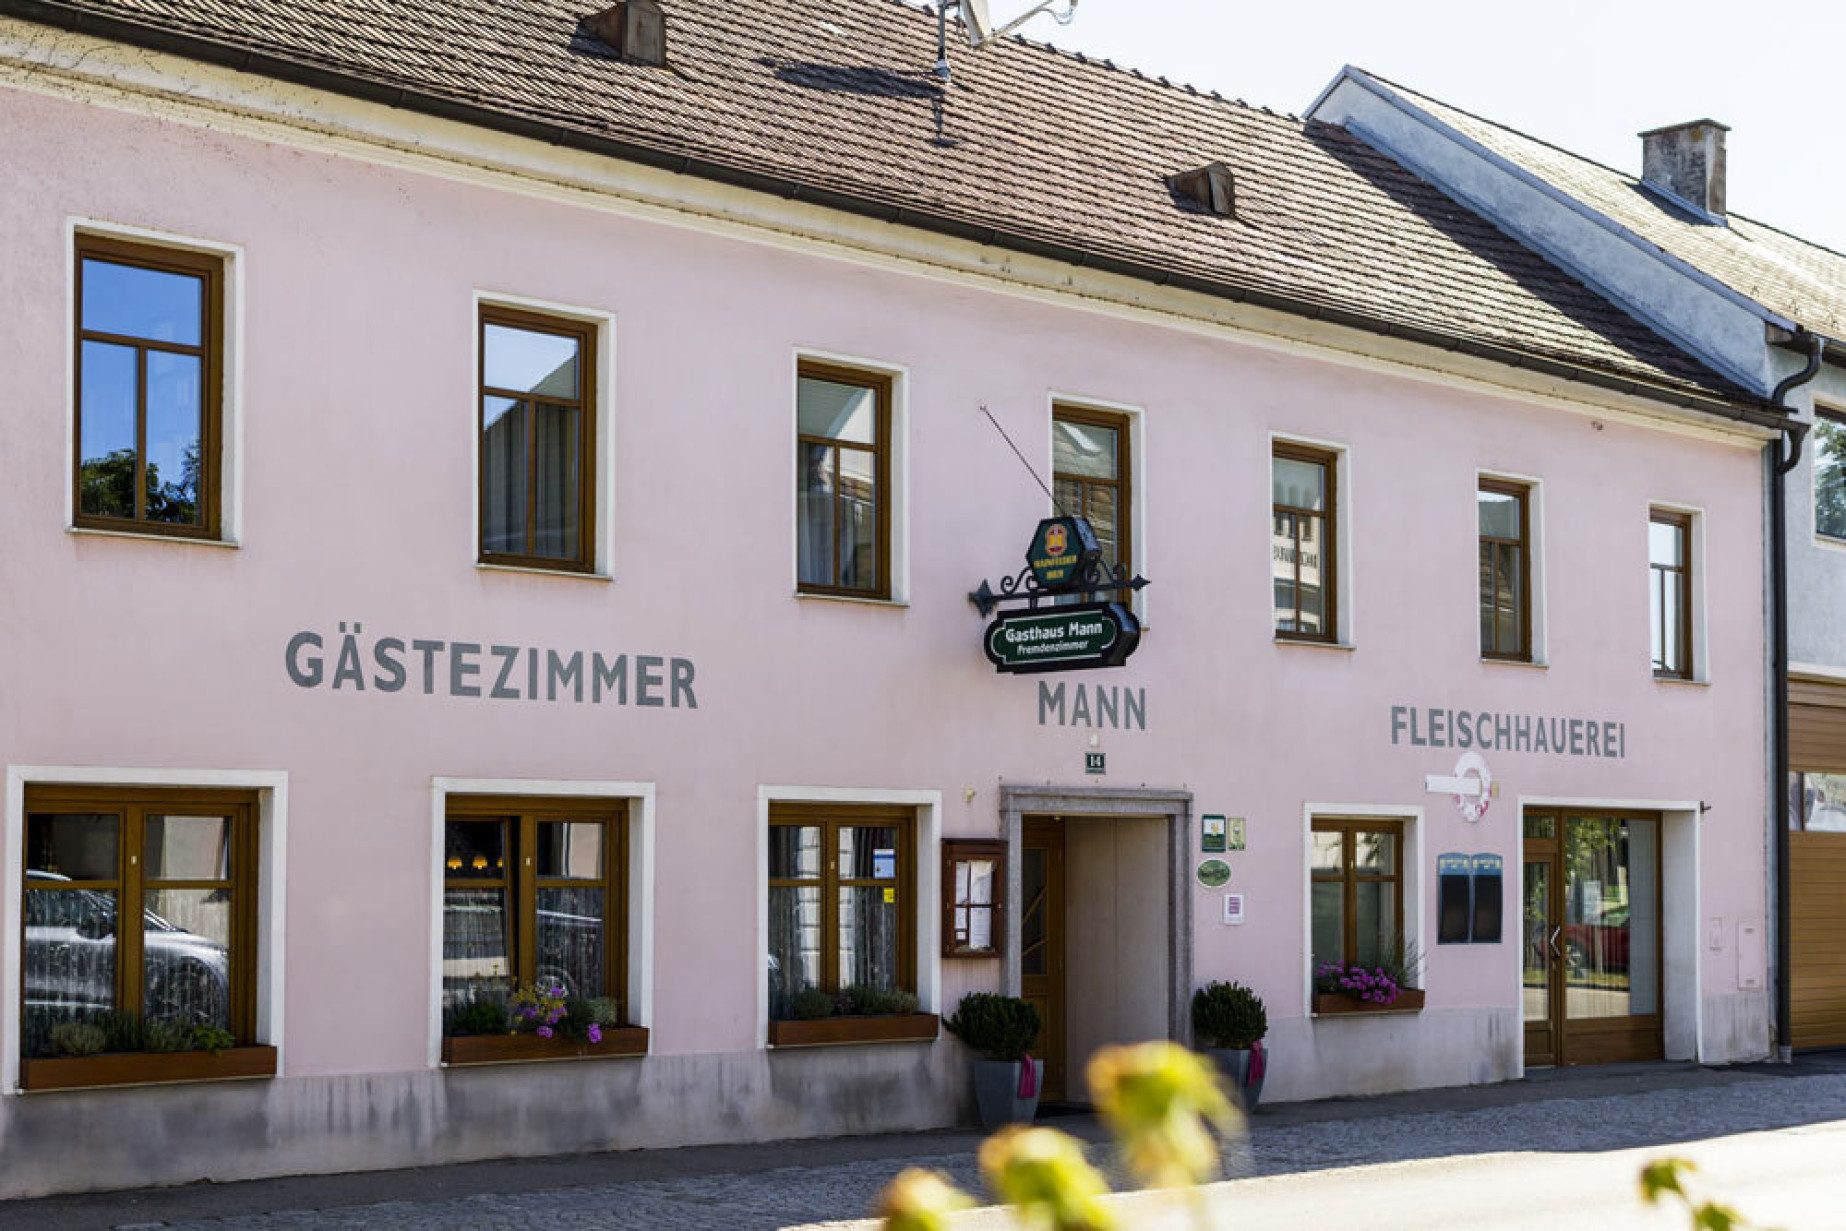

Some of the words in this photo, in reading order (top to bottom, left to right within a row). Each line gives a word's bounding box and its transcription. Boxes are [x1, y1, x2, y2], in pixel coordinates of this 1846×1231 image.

[1005, 626, 1064, 643] Gasthaus
[1068, 621, 1103, 637] Mann
[1016, 640, 1089, 656] Fremdenzimmer
[285, 622, 698, 709] GÄSTEZIMMER
[1038, 680, 1146, 730] MANN
[1391, 706, 1626, 758] FLEISCHHAUEREI
